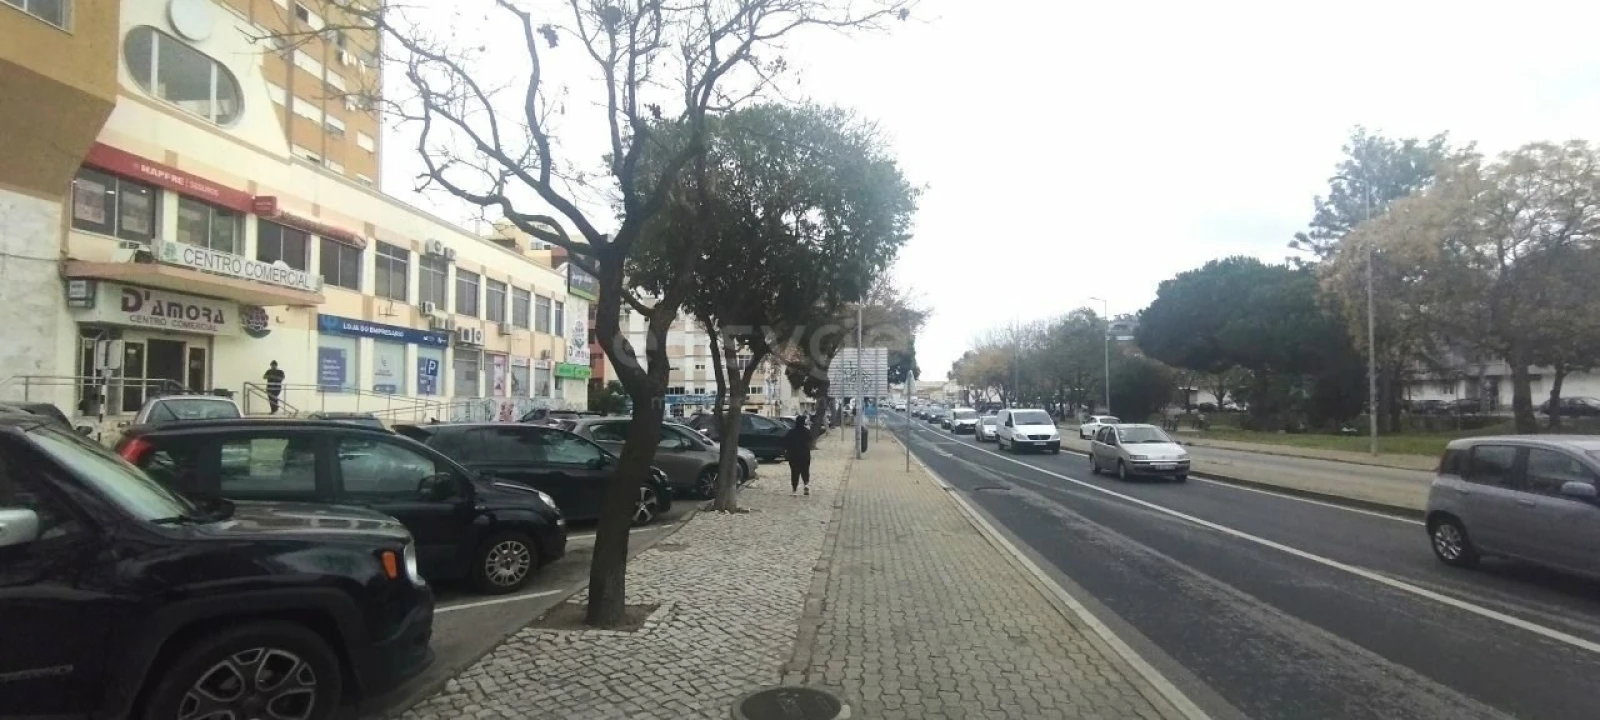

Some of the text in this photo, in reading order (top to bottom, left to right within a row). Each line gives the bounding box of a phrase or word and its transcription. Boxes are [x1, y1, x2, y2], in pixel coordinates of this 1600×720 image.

[140, 164, 185, 186] MAPFRE
[183, 248, 310, 288] CENTRO COMERCIAL
[129, 314, 218, 332] CENTRO COMERCIAL
[343, 322, 360, 331] LOJA
[428, 360, 437, 375] P
